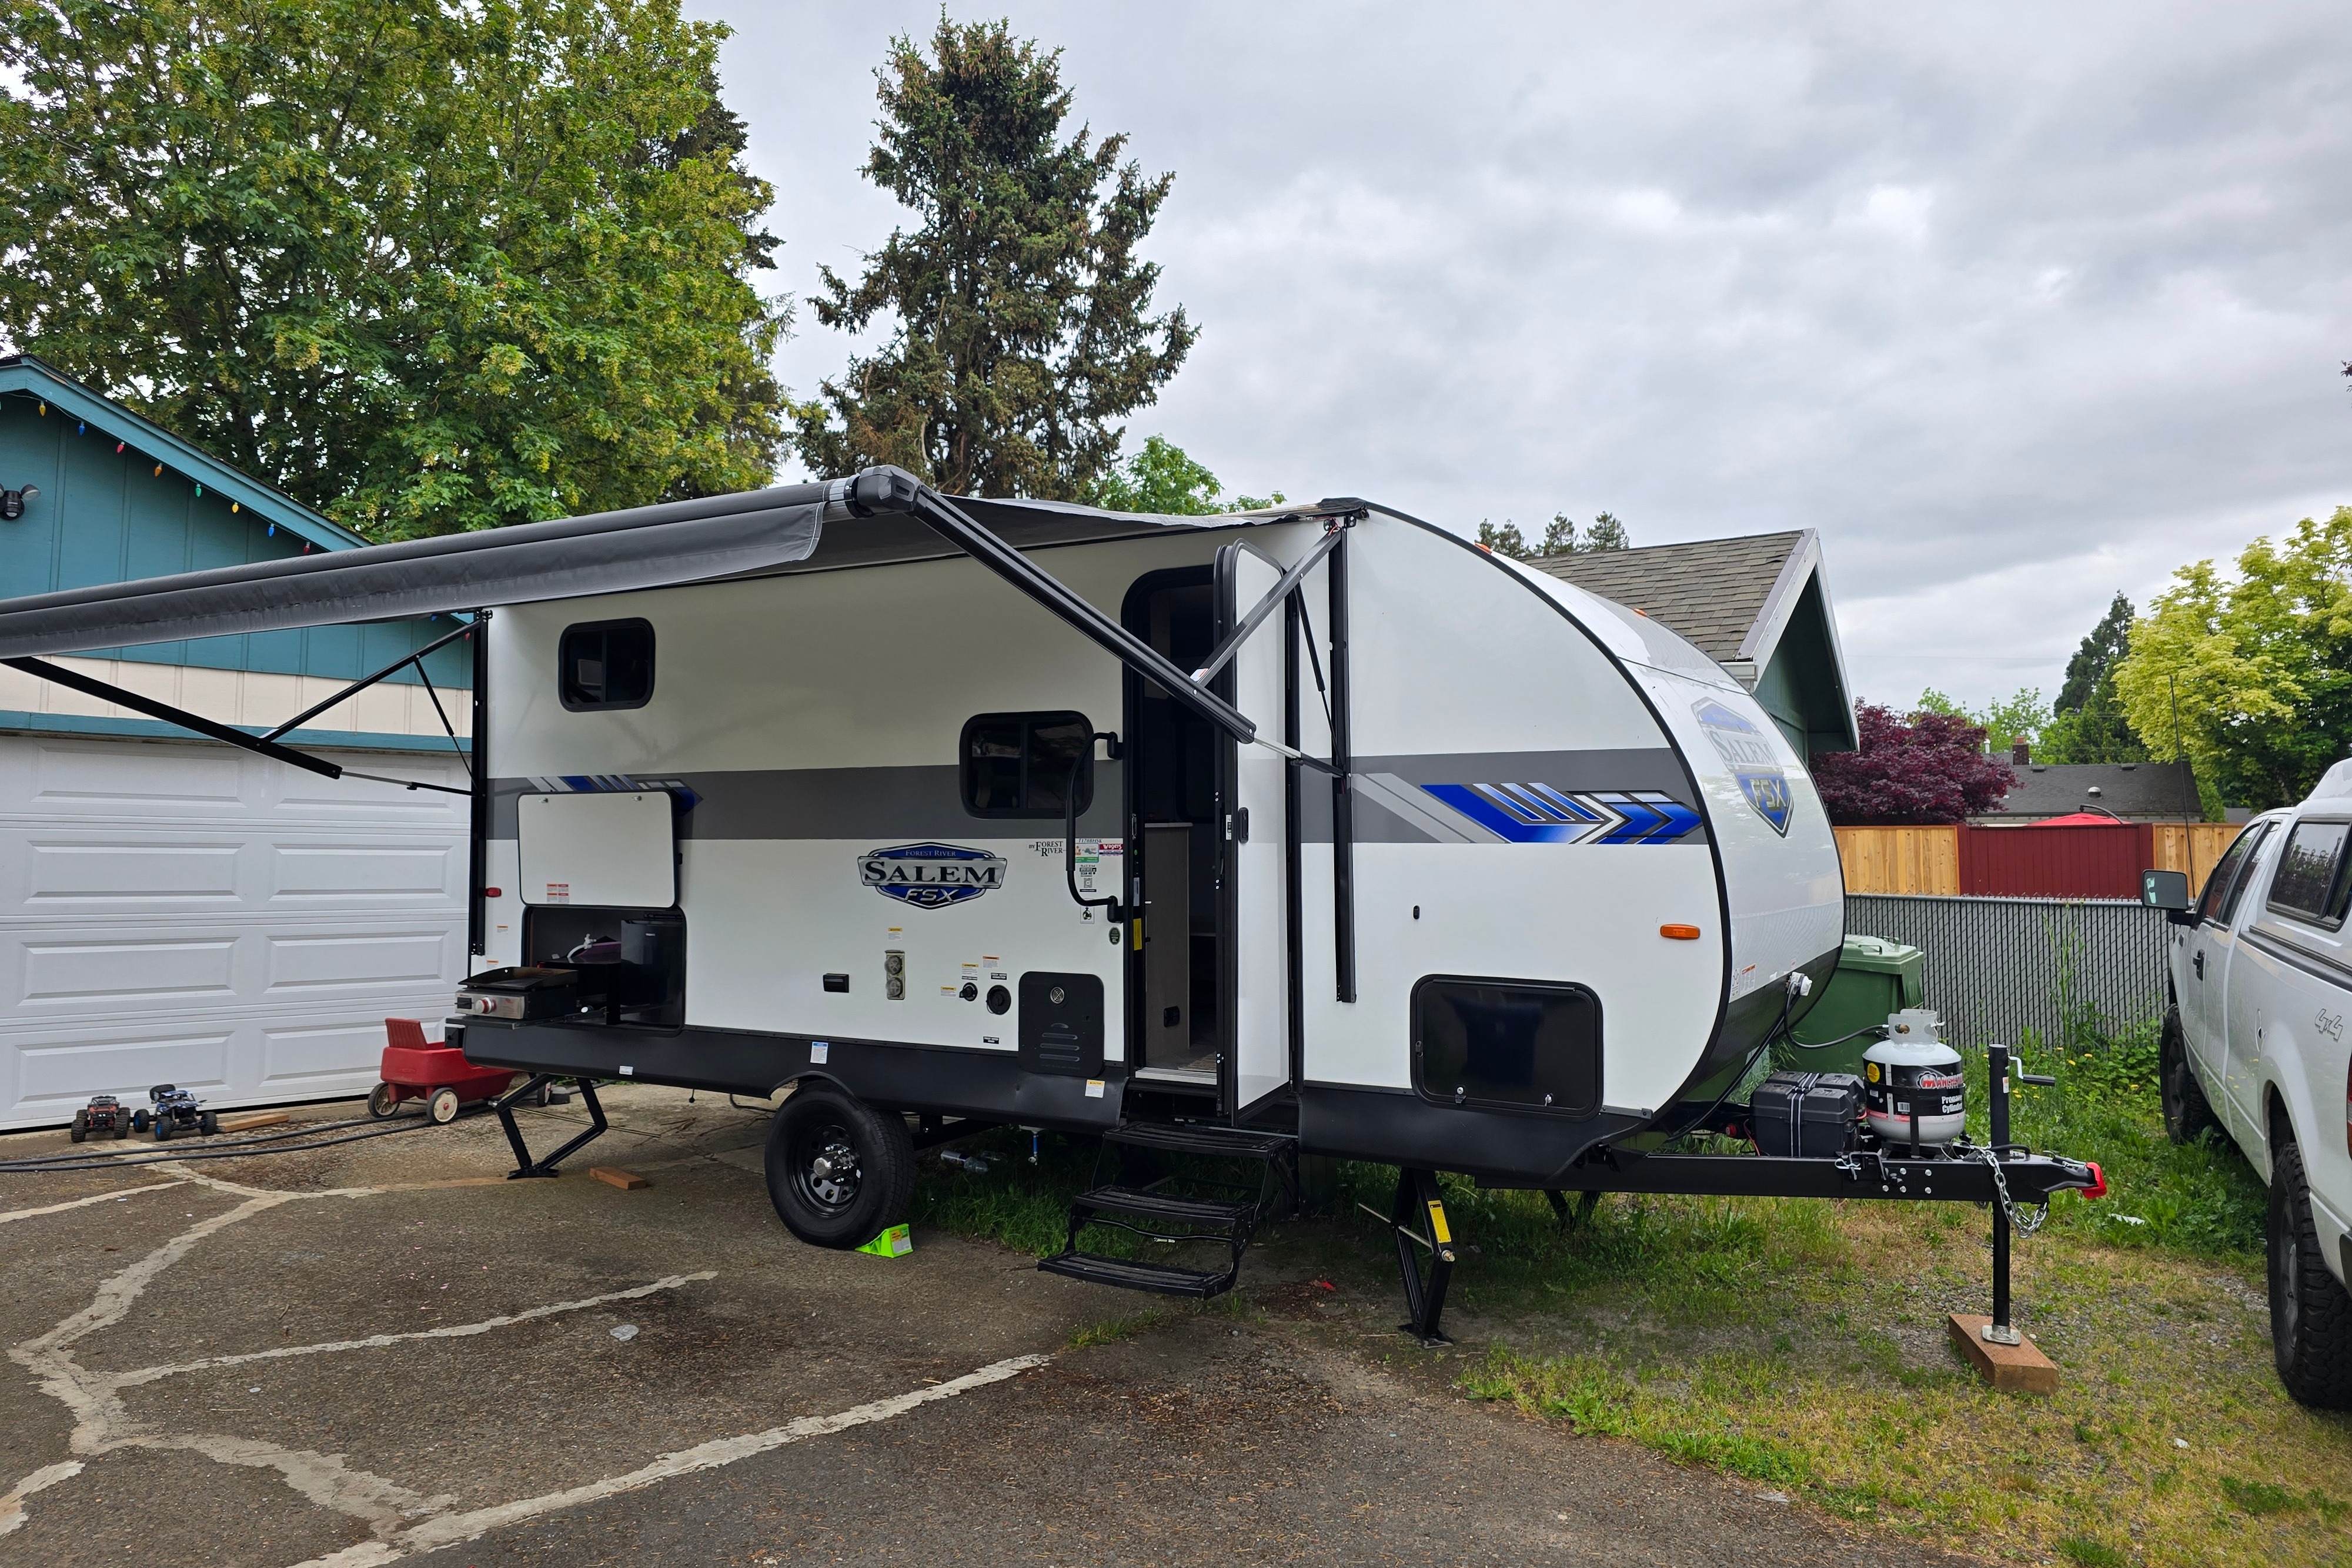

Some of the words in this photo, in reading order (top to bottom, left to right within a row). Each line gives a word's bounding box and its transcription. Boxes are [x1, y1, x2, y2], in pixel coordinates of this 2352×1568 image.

[1709, 730, 1779, 764] SALEM
[1749, 778, 1786, 808] FSX
[1034, 841, 1063, 851] FOREST
[1041, 847, 1063, 857] RIVER
[865, 861, 1000, 884] SALEM
[904, 888, 959, 902] FSX
[2314, 1008, 2343, 1042] 4x4
